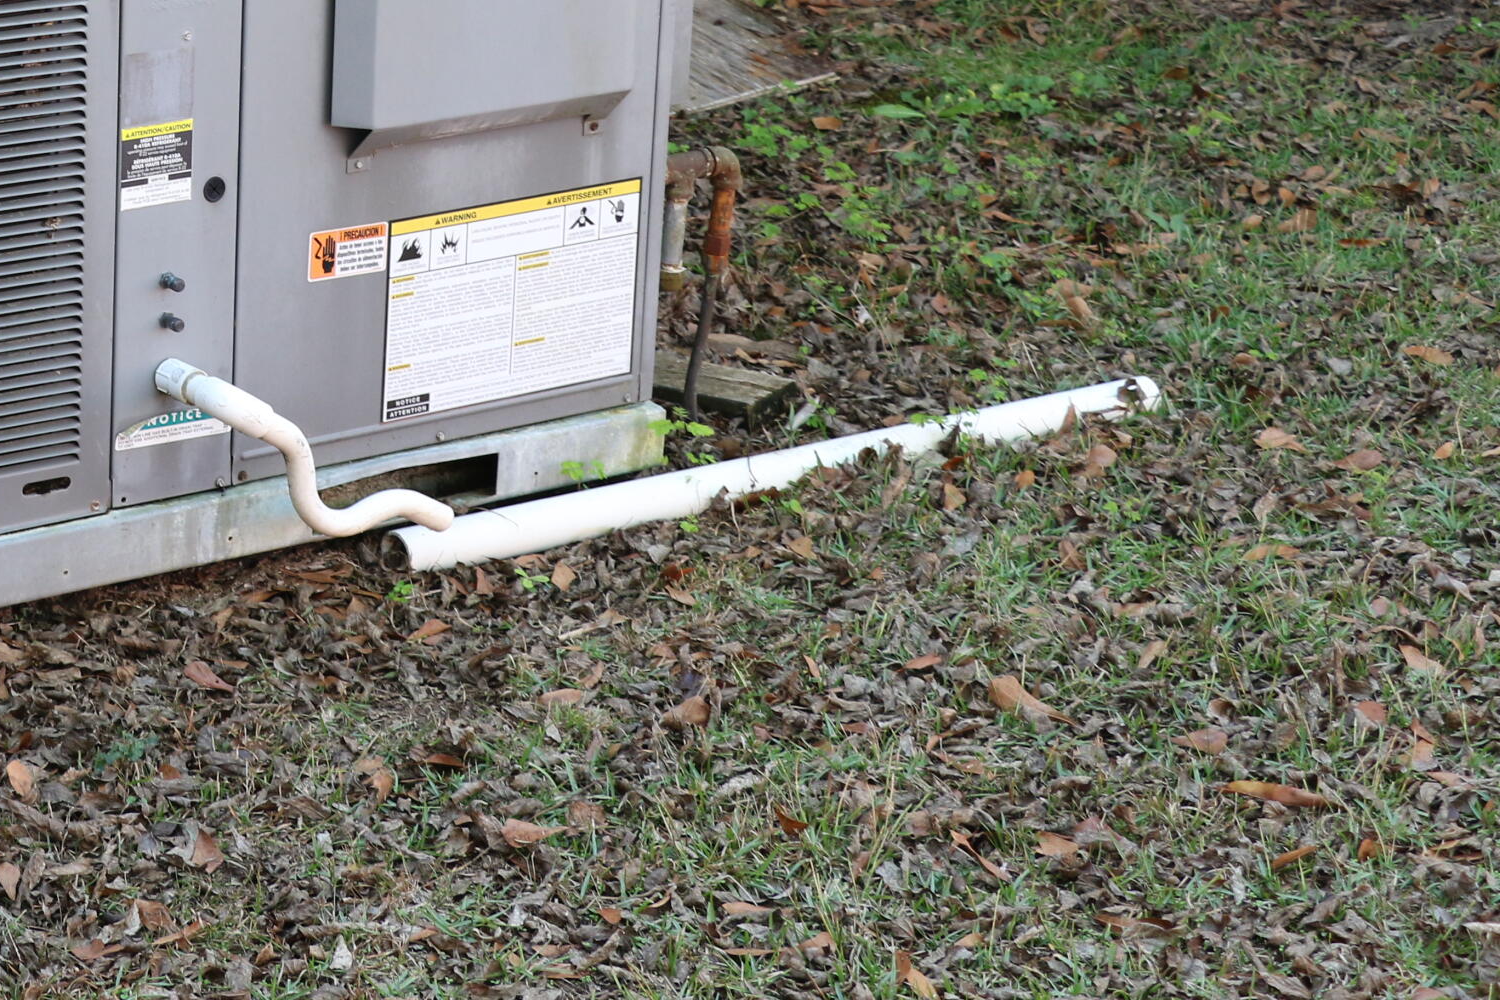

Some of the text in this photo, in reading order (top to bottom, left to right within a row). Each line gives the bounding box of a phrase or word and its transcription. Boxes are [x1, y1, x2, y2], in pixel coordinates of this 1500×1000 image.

[551, 187, 613, 204] AVERTISSEMENT
[441, 211, 477, 224] WARNING
[395, 396, 421, 406] NOTICE
[389, 404, 428, 418] ATTENTION
